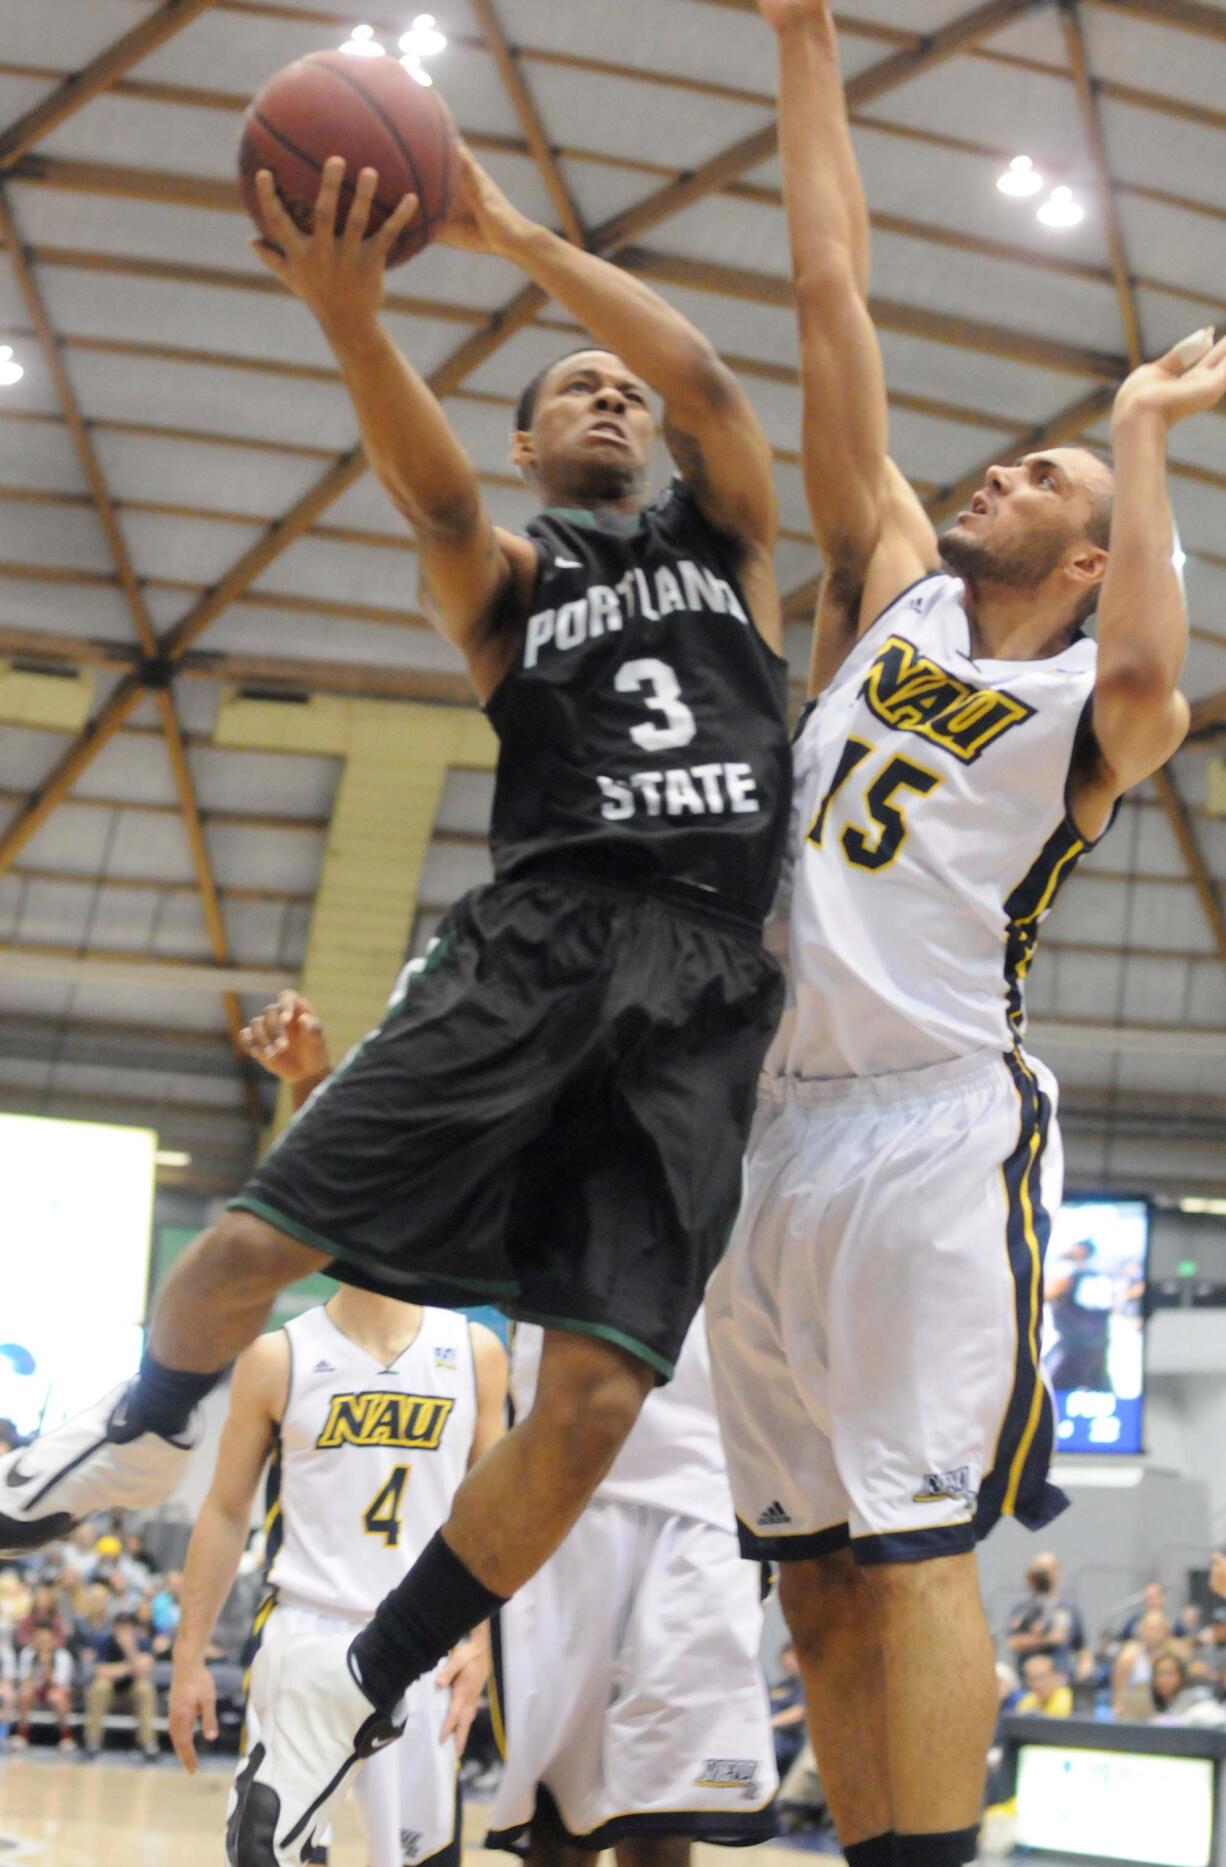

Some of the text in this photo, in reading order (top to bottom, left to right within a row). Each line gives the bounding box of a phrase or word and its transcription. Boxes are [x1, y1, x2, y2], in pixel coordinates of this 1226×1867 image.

[614, 658, 696, 752] 3
[856, 634, 1038, 766] NAU
[596, 762, 760, 820] STATE
[805, 735, 944, 874] 15
[315, 1391, 455, 1451] NAU
[363, 1463, 412, 1549] 4
